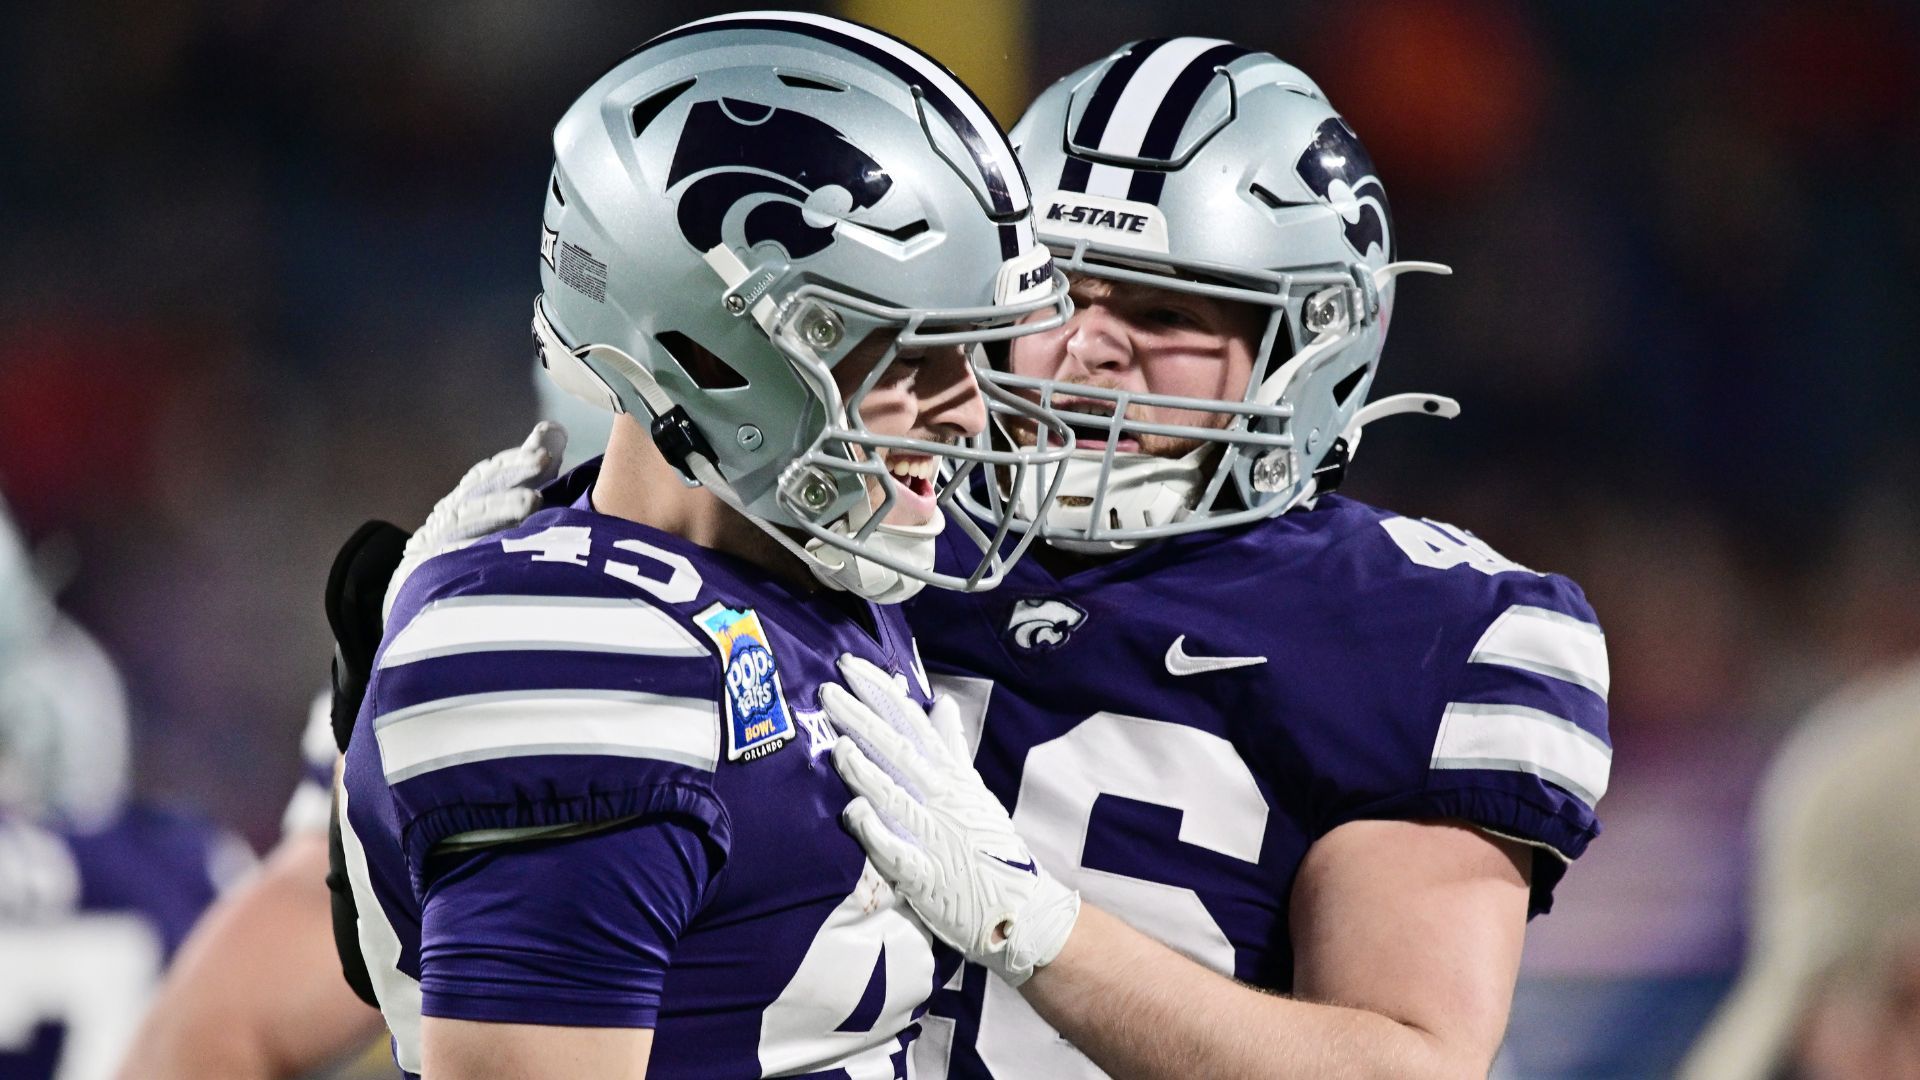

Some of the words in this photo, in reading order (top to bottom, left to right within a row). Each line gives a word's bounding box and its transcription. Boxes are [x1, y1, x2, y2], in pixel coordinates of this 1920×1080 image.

[1046, 203, 1149, 233] K-STATE
[745, 718, 776, 743] BOWL
[744, 739, 783, 761] ORLANDO
